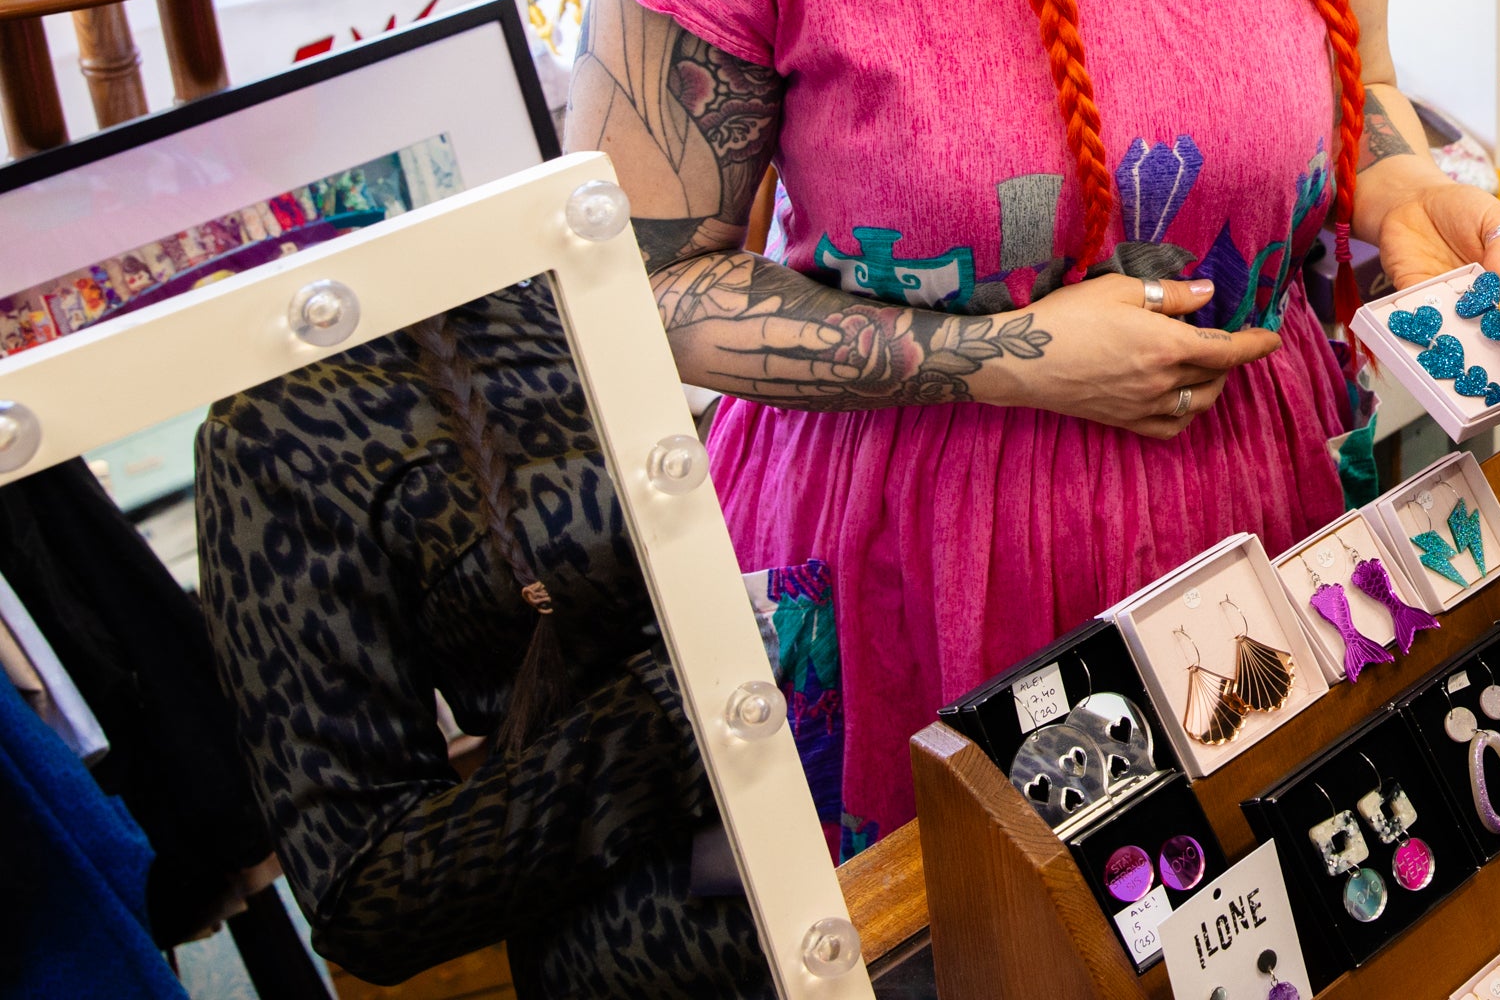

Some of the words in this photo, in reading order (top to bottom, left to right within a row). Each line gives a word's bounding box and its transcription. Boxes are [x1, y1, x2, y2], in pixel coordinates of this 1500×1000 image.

[1020, 676, 1045, 691] ALE!
[1035, 702, 1058, 722] (29)
[1110, 857, 1147, 889] STRONG
[1111, 853, 1131, 873] STAY
[1126, 876, 1142, 892] SIS
[1131, 896, 1158, 917] ALE!
[1132, 921, 1141, 933] 15
[1194, 888, 1267, 970] ILONE
[1134, 930, 1155, 953] (25)
